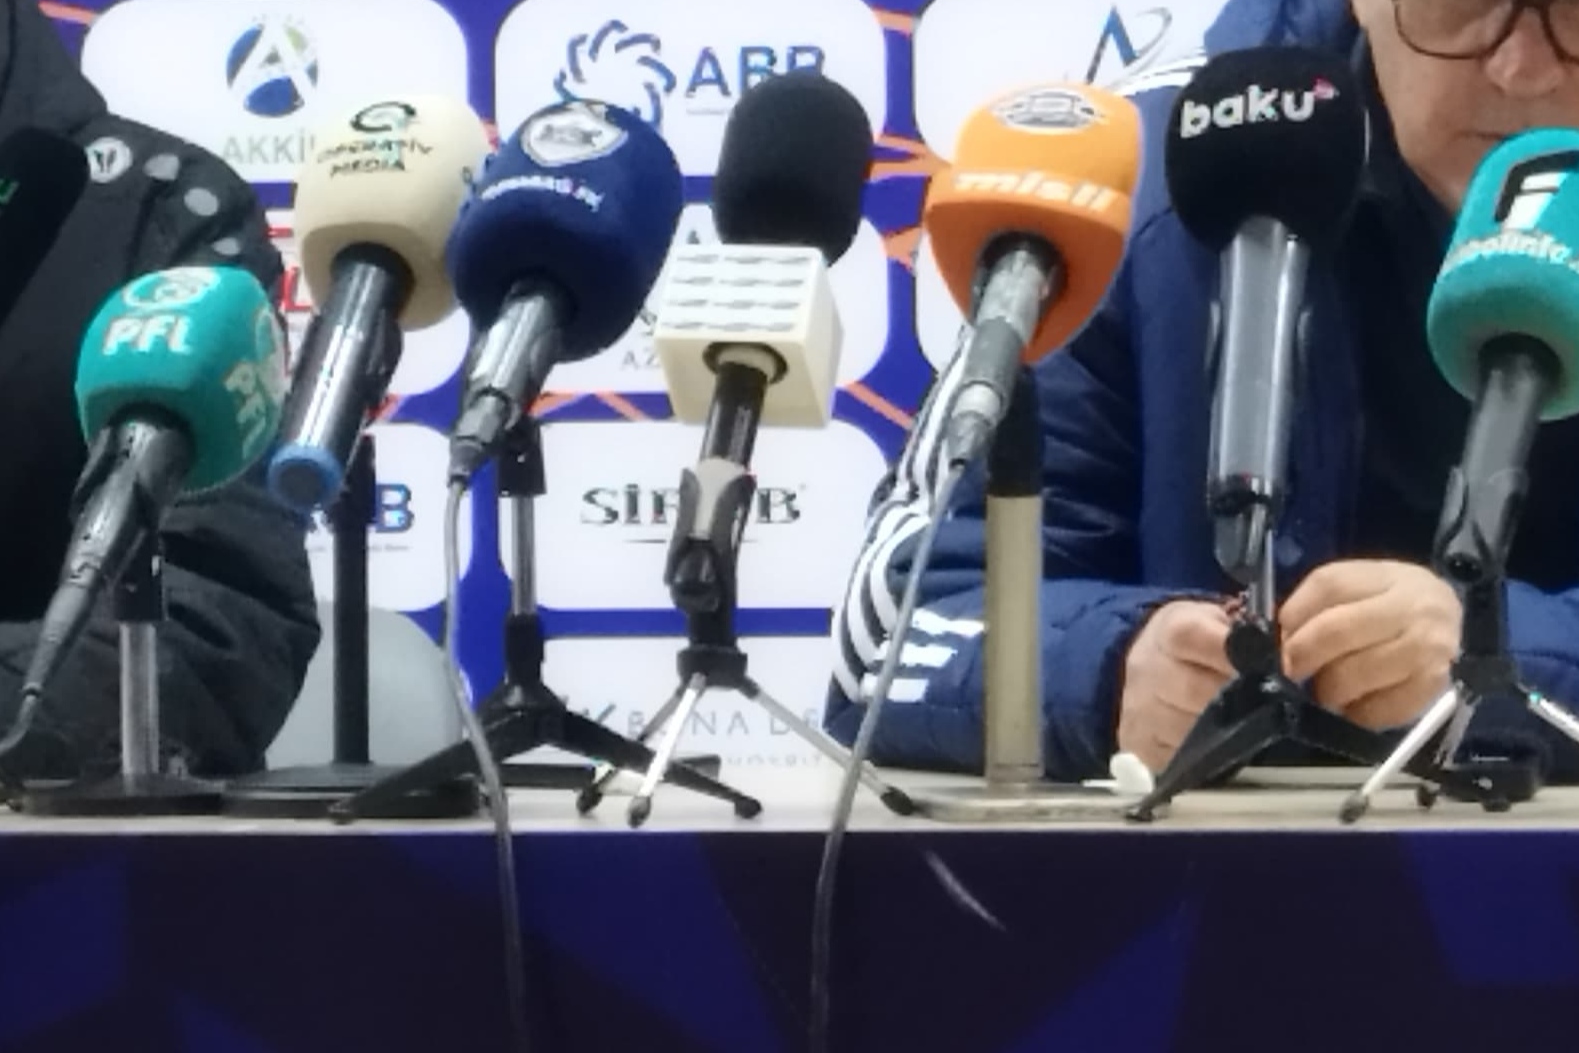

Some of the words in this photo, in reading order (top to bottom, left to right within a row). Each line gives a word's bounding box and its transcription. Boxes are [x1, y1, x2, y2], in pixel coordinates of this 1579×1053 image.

[1179, 83, 1317, 138] baku
[223, 126, 317, 165] AKKİ
[102, 313, 194, 357] PFL
